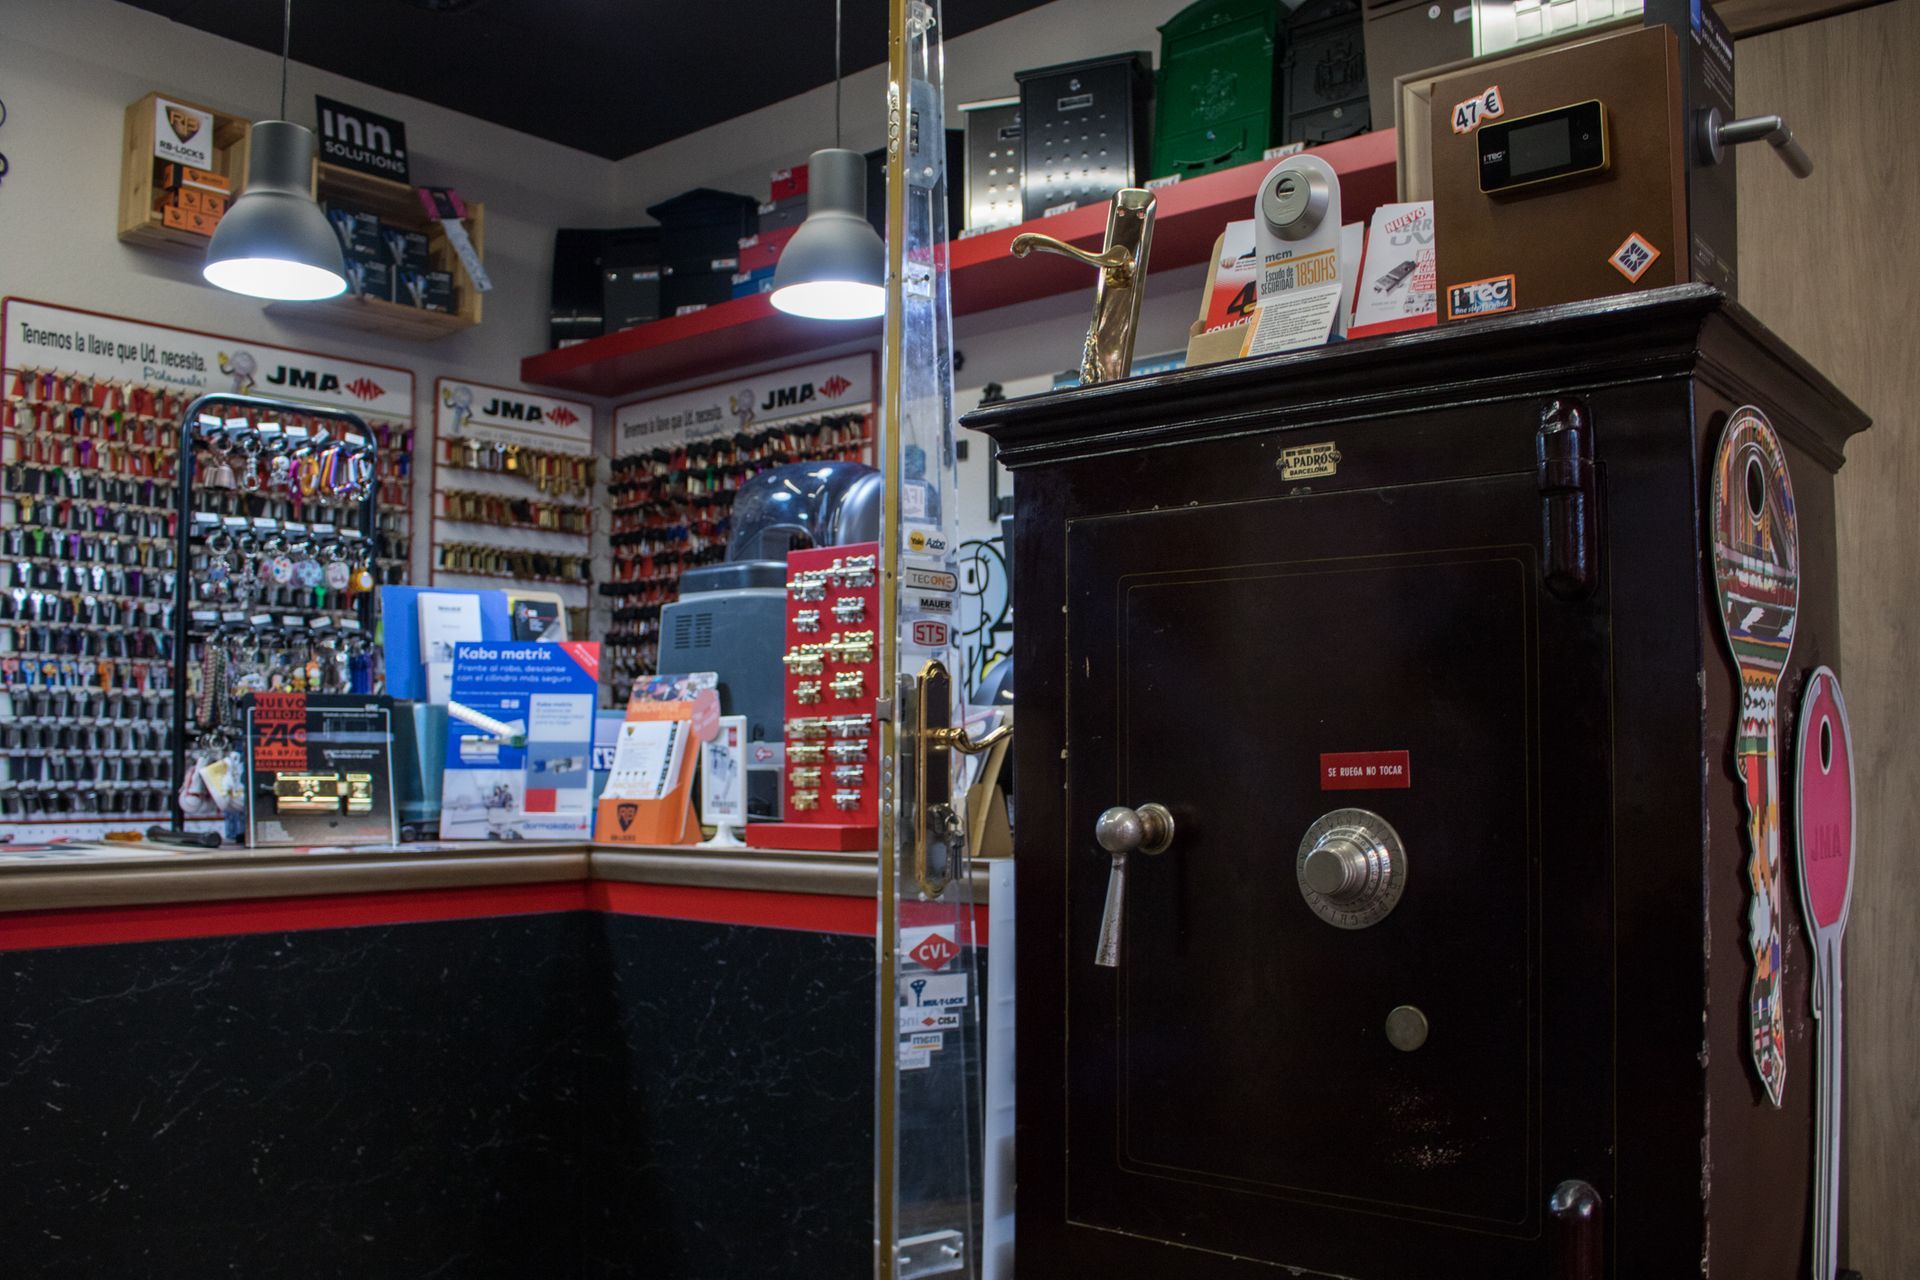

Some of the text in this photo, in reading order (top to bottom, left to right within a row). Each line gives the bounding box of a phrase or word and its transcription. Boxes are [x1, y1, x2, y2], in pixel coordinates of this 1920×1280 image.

[1456, 92, 1500, 128] 47 €
[325, 140, 406, 175] SOLUTIONS
[1385, 207, 1427, 234] NUEVO
[1265, 249, 1293, 263] mcm
[1265, 265, 1294, 283] Escudo de
[1295, 255, 1336, 288] 1850HS
[1261, 276, 1294, 296] SEGURIDAD
[21, 322, 207, 372] Tenemos la llave que Ud. necesita.
[266, 366, 341, 394] JMA
[761, 383, 816, 411] JMA
[483, 397, 543, 423] JMA
[1289, 466, 1328, 476] BARCELONA
[920, 598, 952, 610] MAUER
[915, 624, 945, 643] STS
[458, 647, 551, 661] Kaba matrix
[457, 664, 487, 672] Frente
[500, 665, 523, 673] robo,
[474, 674, 484, 682] el
[485, 674, 518, 683] cilindro
[519, 675, 540, 683] más
[541, 676, 573, 685] seguro
[255, 698, 305, 708] NUEVO
[1328, 765, 1403, 777] SE RUEGA NO TOCAR
[919, 942, 951, 961] CVL
[937, 1016, 957, 1025] CISA
[912, 1035, 940, 1045] mcm
